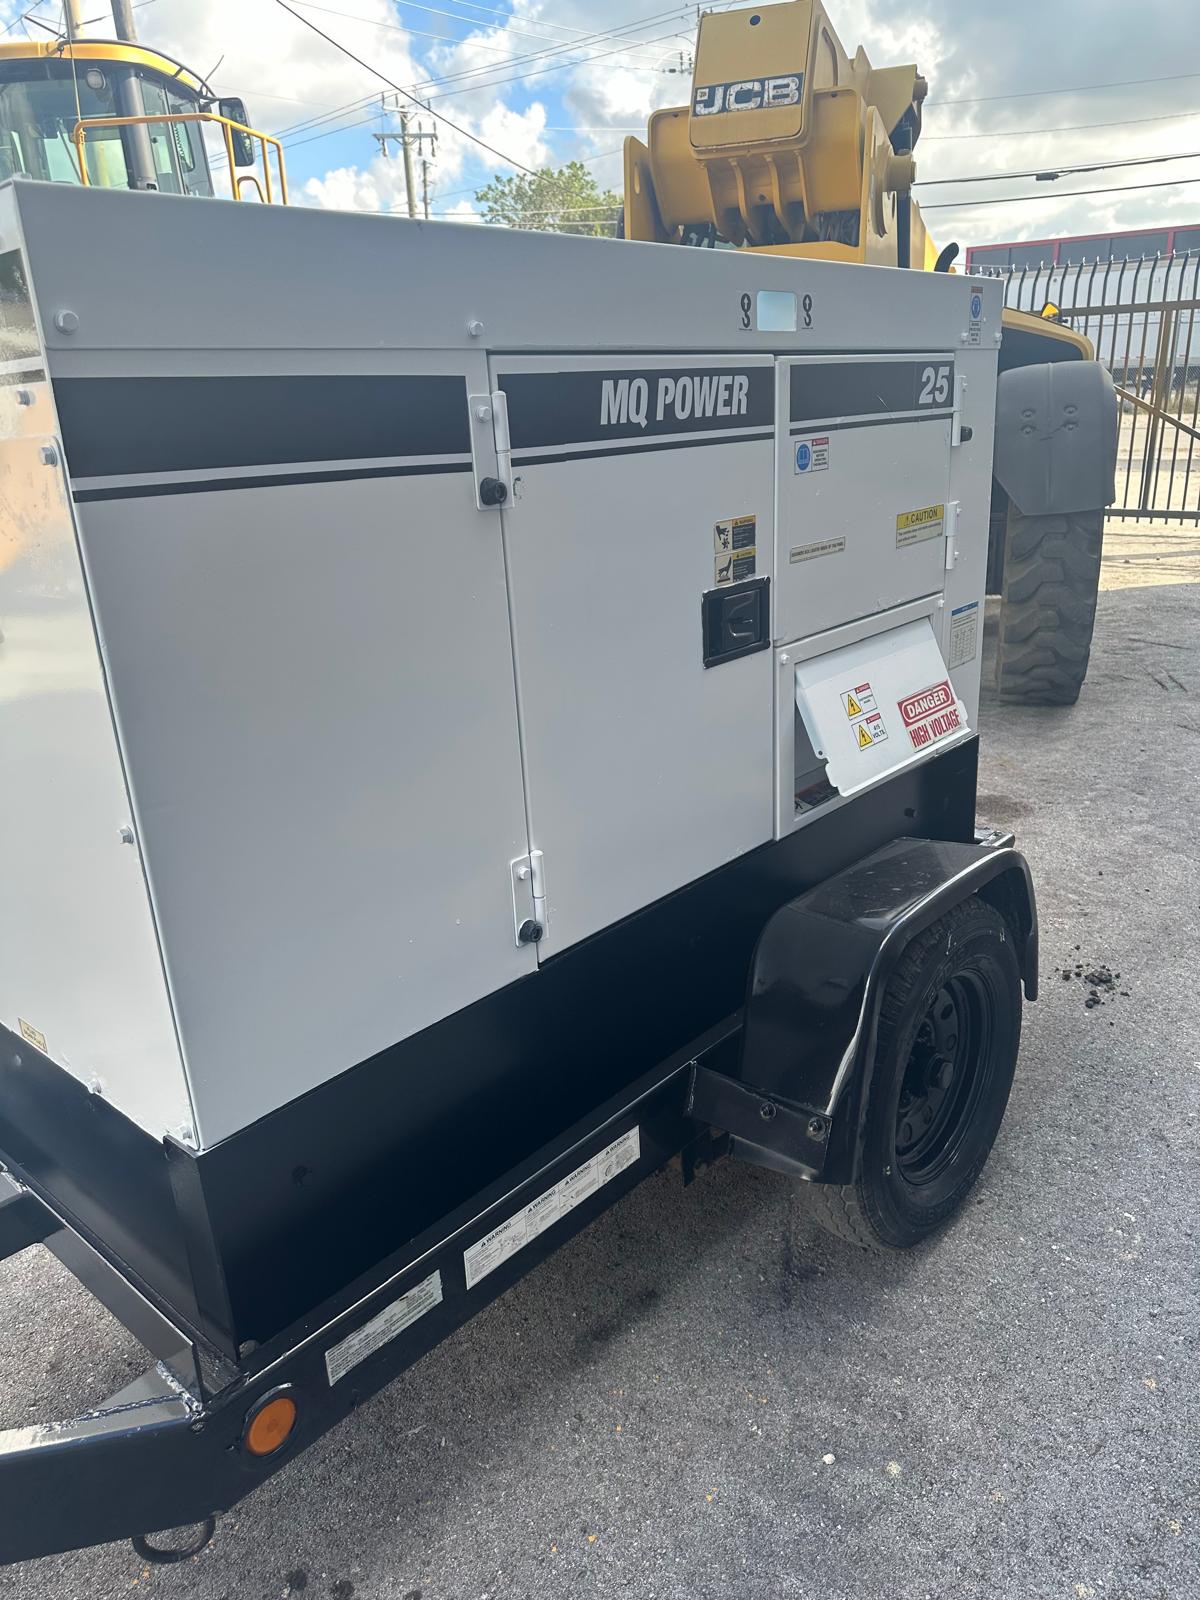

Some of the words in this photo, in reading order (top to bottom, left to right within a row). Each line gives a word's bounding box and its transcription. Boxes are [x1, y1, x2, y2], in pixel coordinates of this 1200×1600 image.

[695, 77, 799, 115] JCB
[918, 366, 950, 404] 25
[600, 377, 649, 429] MQ
[656, 375, 749, 421] POWER
[910, 508, 938, 524] CAUTION
[906, 689, 947, 718] DANGER
[909, 725, 932, 748] HIGH
[930, 708, 961, 738] VOLTAGE
[532, 1189, 557, 1209] WARNING
[486, 1221, 512, 1243] WARNING
